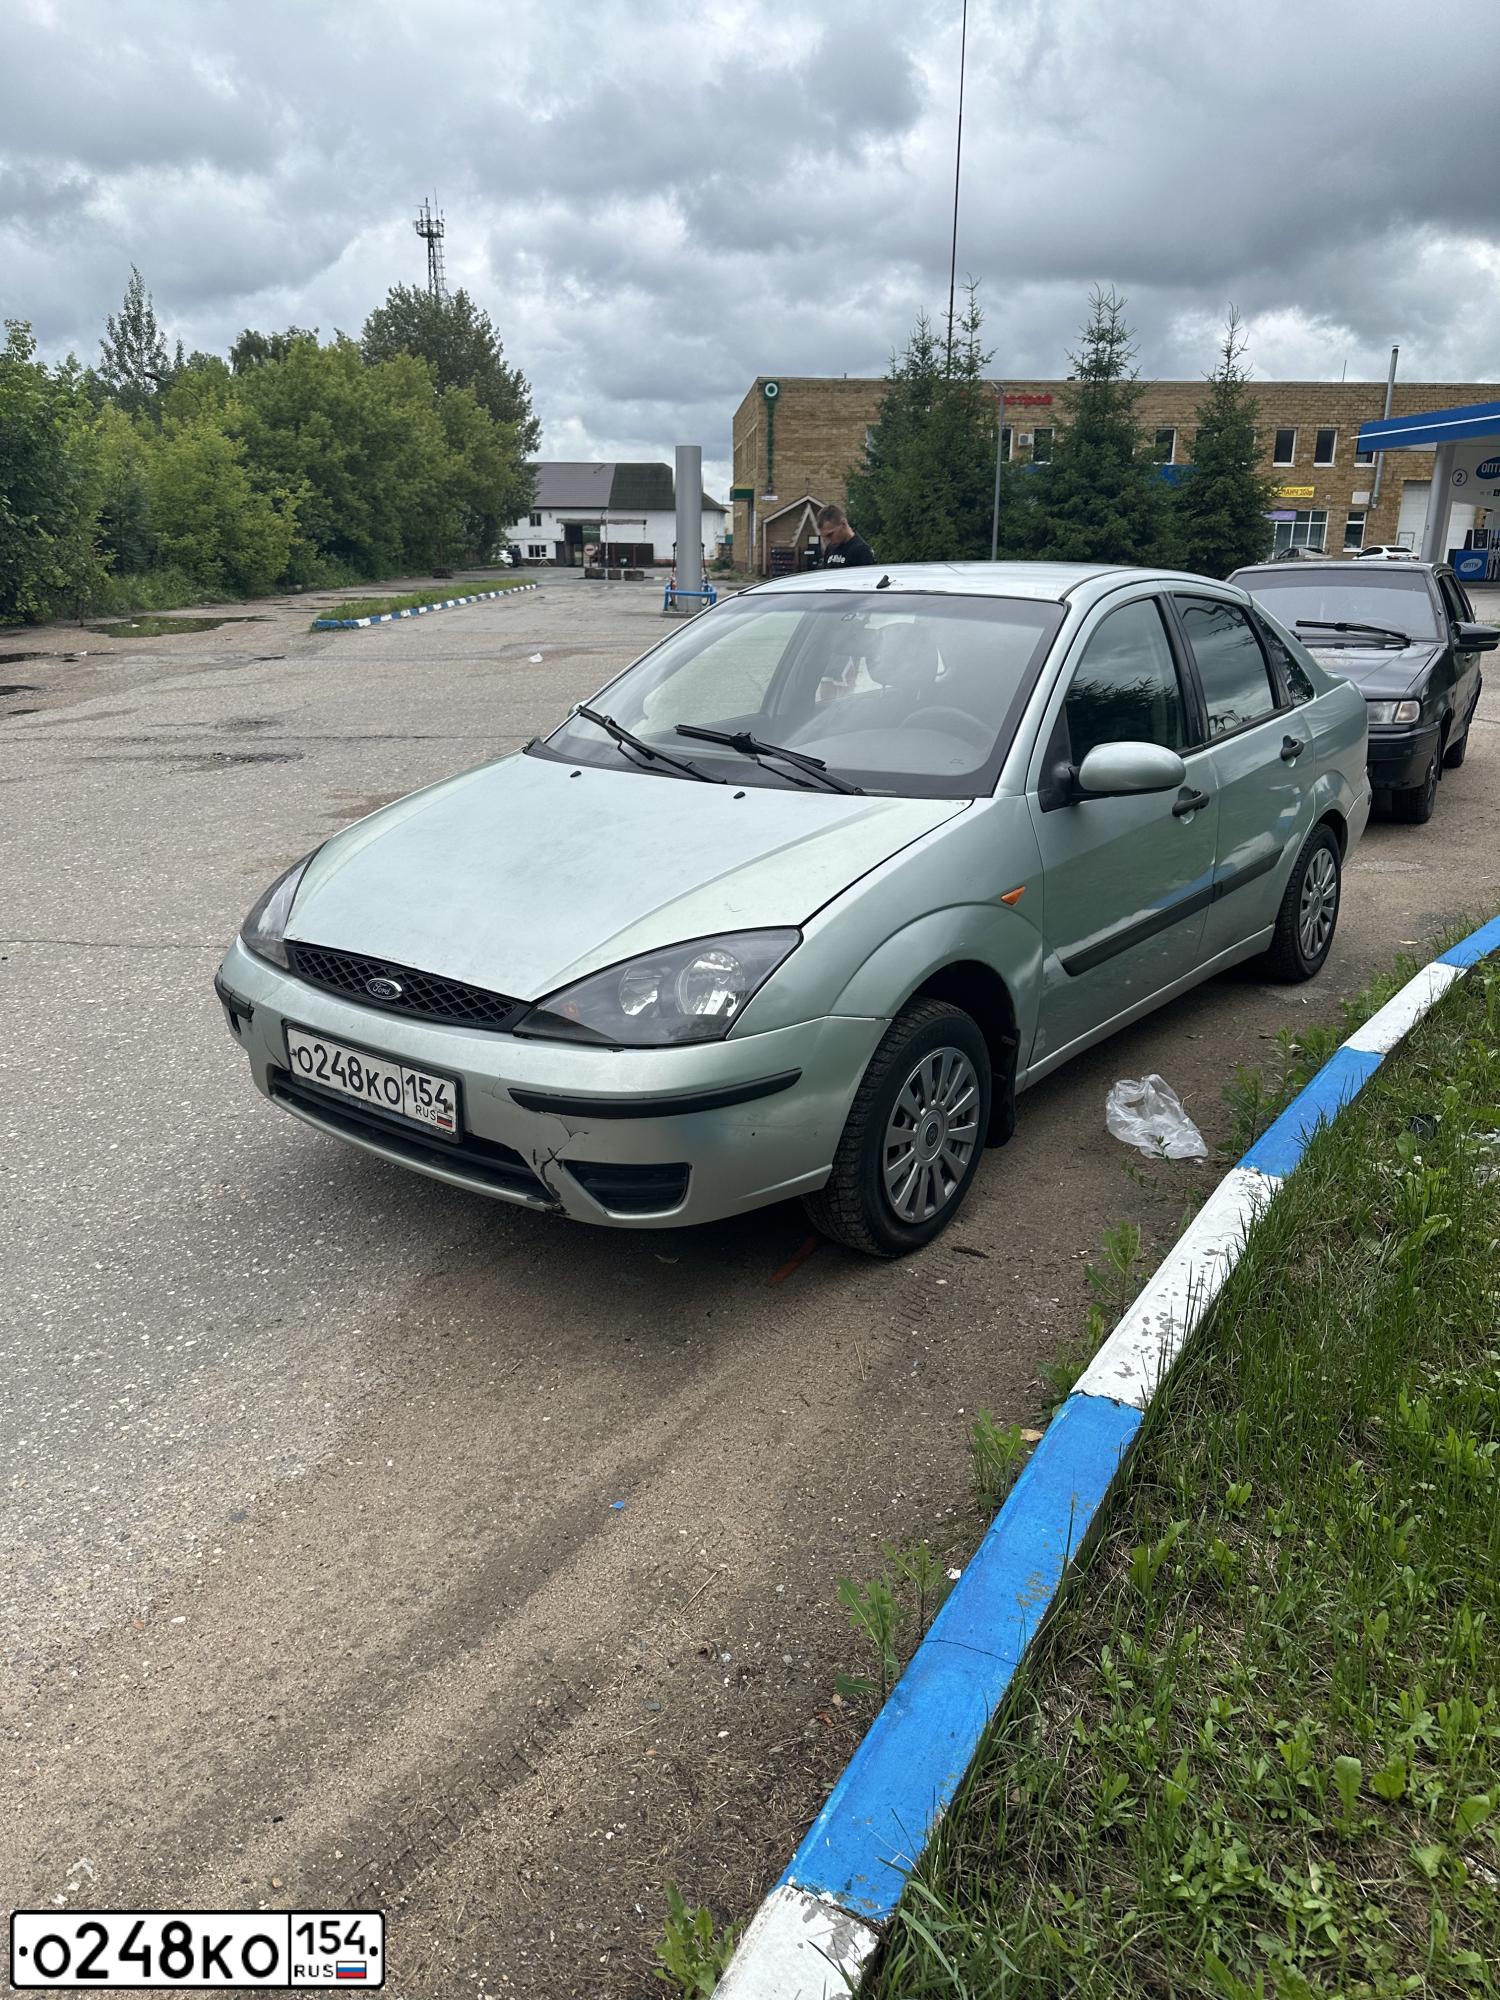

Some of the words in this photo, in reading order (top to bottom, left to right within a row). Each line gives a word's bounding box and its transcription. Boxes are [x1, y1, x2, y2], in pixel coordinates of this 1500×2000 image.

[1456, 472, 1463, 483] 2
[371, 982, 392, 995] Ford
[298, 1043, 401, 1105] О248КО
[405, 1074, 449, 1113] 154
[415, 1105, 436, 1120] RUS
